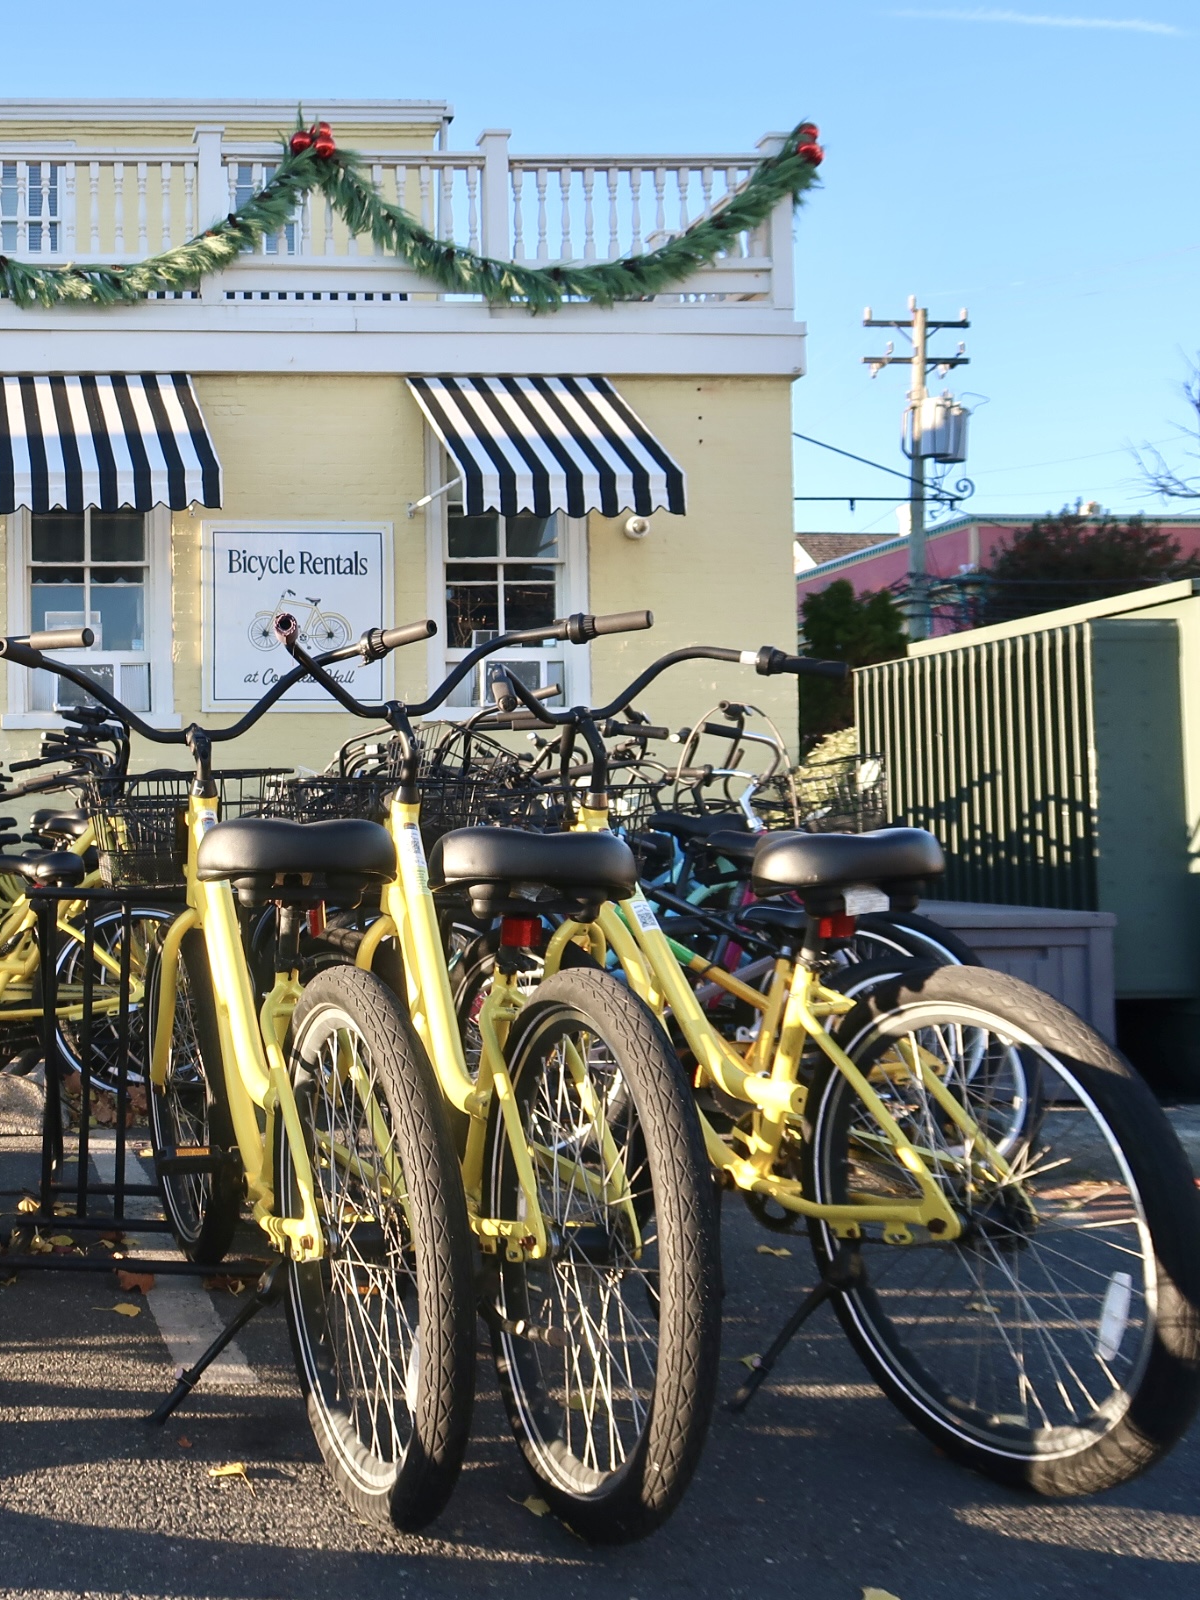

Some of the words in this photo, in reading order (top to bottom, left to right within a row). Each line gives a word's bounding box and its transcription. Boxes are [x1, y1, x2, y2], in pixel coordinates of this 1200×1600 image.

[228, 549, 295, 581] Bicycle
[299, 551, 368, 576] Rentals
[243, 670, 259, 683] at
